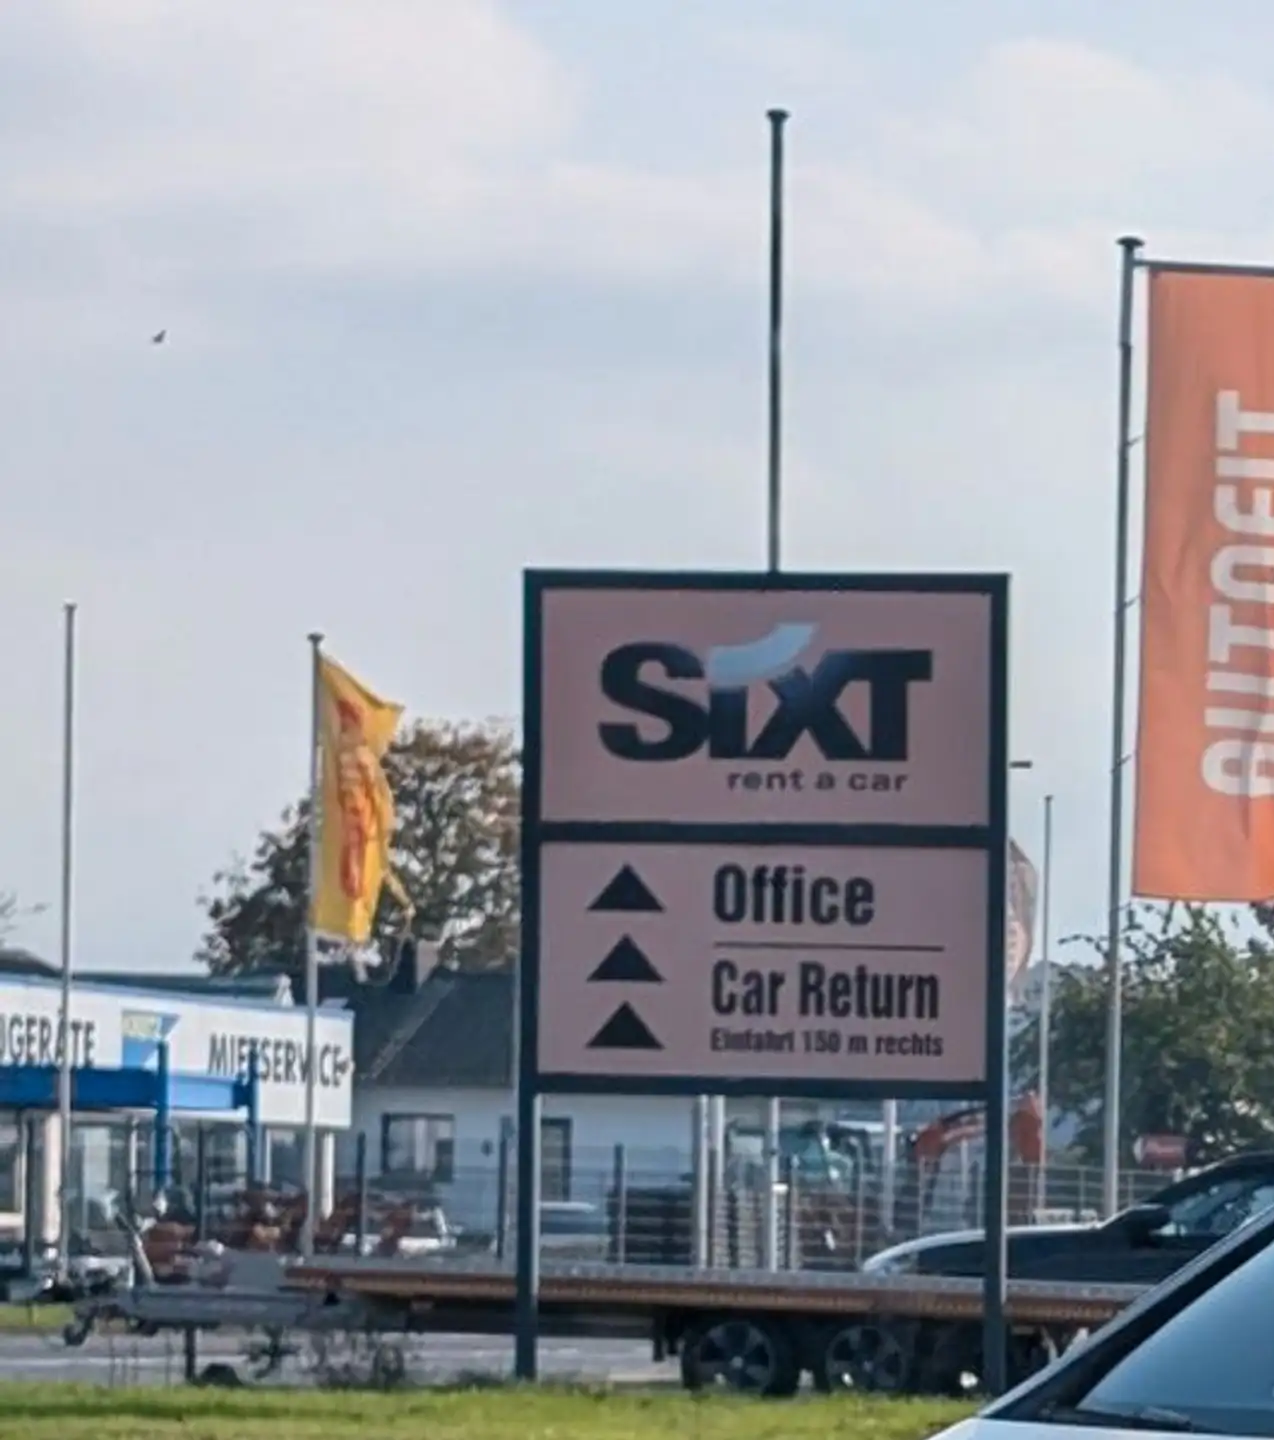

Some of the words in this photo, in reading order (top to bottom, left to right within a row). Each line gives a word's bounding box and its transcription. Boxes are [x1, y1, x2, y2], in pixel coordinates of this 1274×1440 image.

[727, 769, 805, 792] rent
[815, 771, 836, 791] a
[848, 771, 909, 793] car
[713, 862, 876, 926] Office
[711, 958, 785, 1017] Car
[798, 961, 940, 1020] Return
[801, 1029, 842, 1053] 150
[847, 1034, 869, 1055] m
[874, 1032, 944, 1057] rechts
